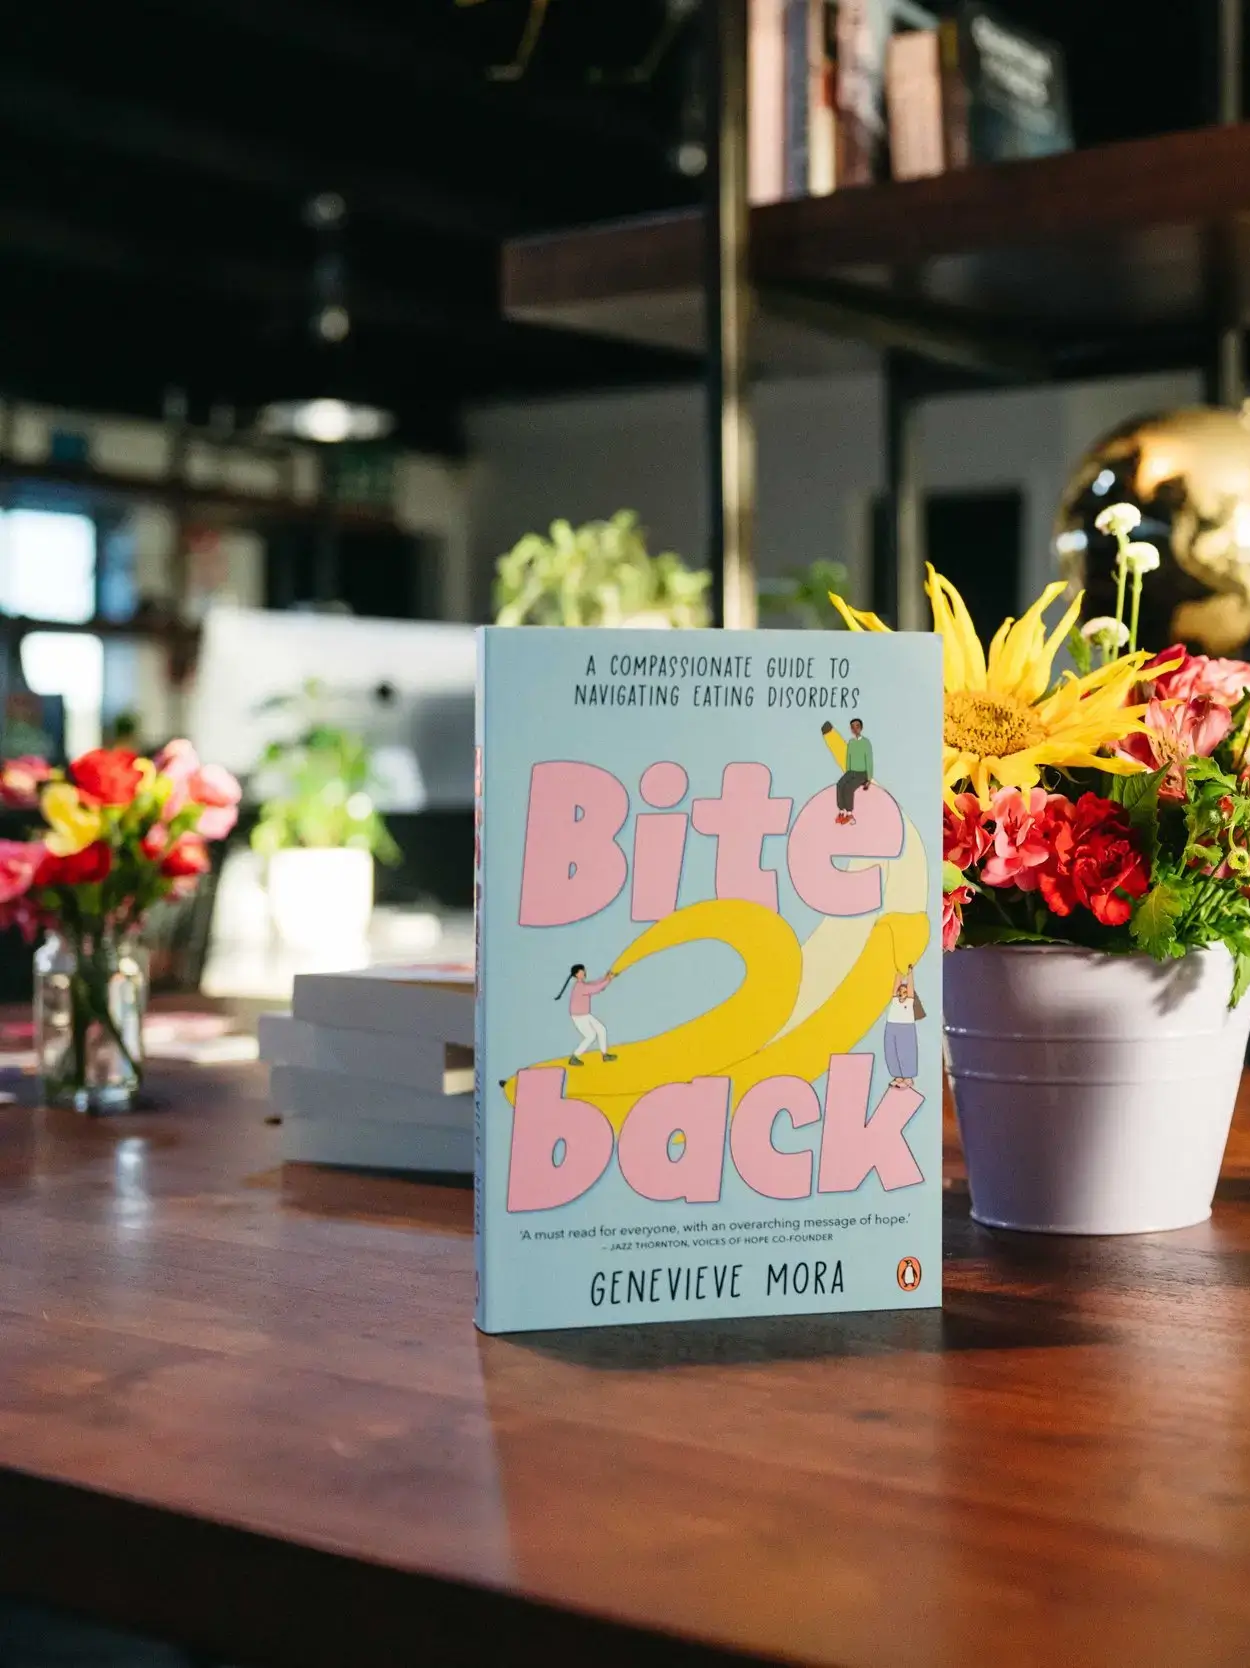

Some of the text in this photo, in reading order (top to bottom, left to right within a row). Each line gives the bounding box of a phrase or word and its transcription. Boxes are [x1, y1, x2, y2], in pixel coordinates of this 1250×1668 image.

[586, 655, 850, 679] A COMPASSIONATE GUIDE TO
[574, 684, 860, 709] NAVIGATING EATING DISORDERS
[518, 760, 905, 927] Bite
[506, 1053, 925, 1213] back
[534, 1230, 565, 1240] must
[568, 1227, 596, 1238] read
[600, 1225, 616, 1237] for
[620, 1224, 680, 1237] everyone,
[683, 1221, 708, 1232] with
[712, 1222, 726, 1231] an
[729, 1218, 800, 1231] overarching
[804, 1217, 856, 1229] message
[860, 1214, 872, 1225] of
[610, 1243, 632, 1251] JAZZ
[636, 1240, 690, 1249] THORNTON,
[692, 1237, 726, 1247] VOICES
[744, 1236, 769, 1244] HOPE
[772, 1233, 833, 1243] CO-FOUNDER
[590, 1259, 844, 1307] GENEVIEVE MORA
